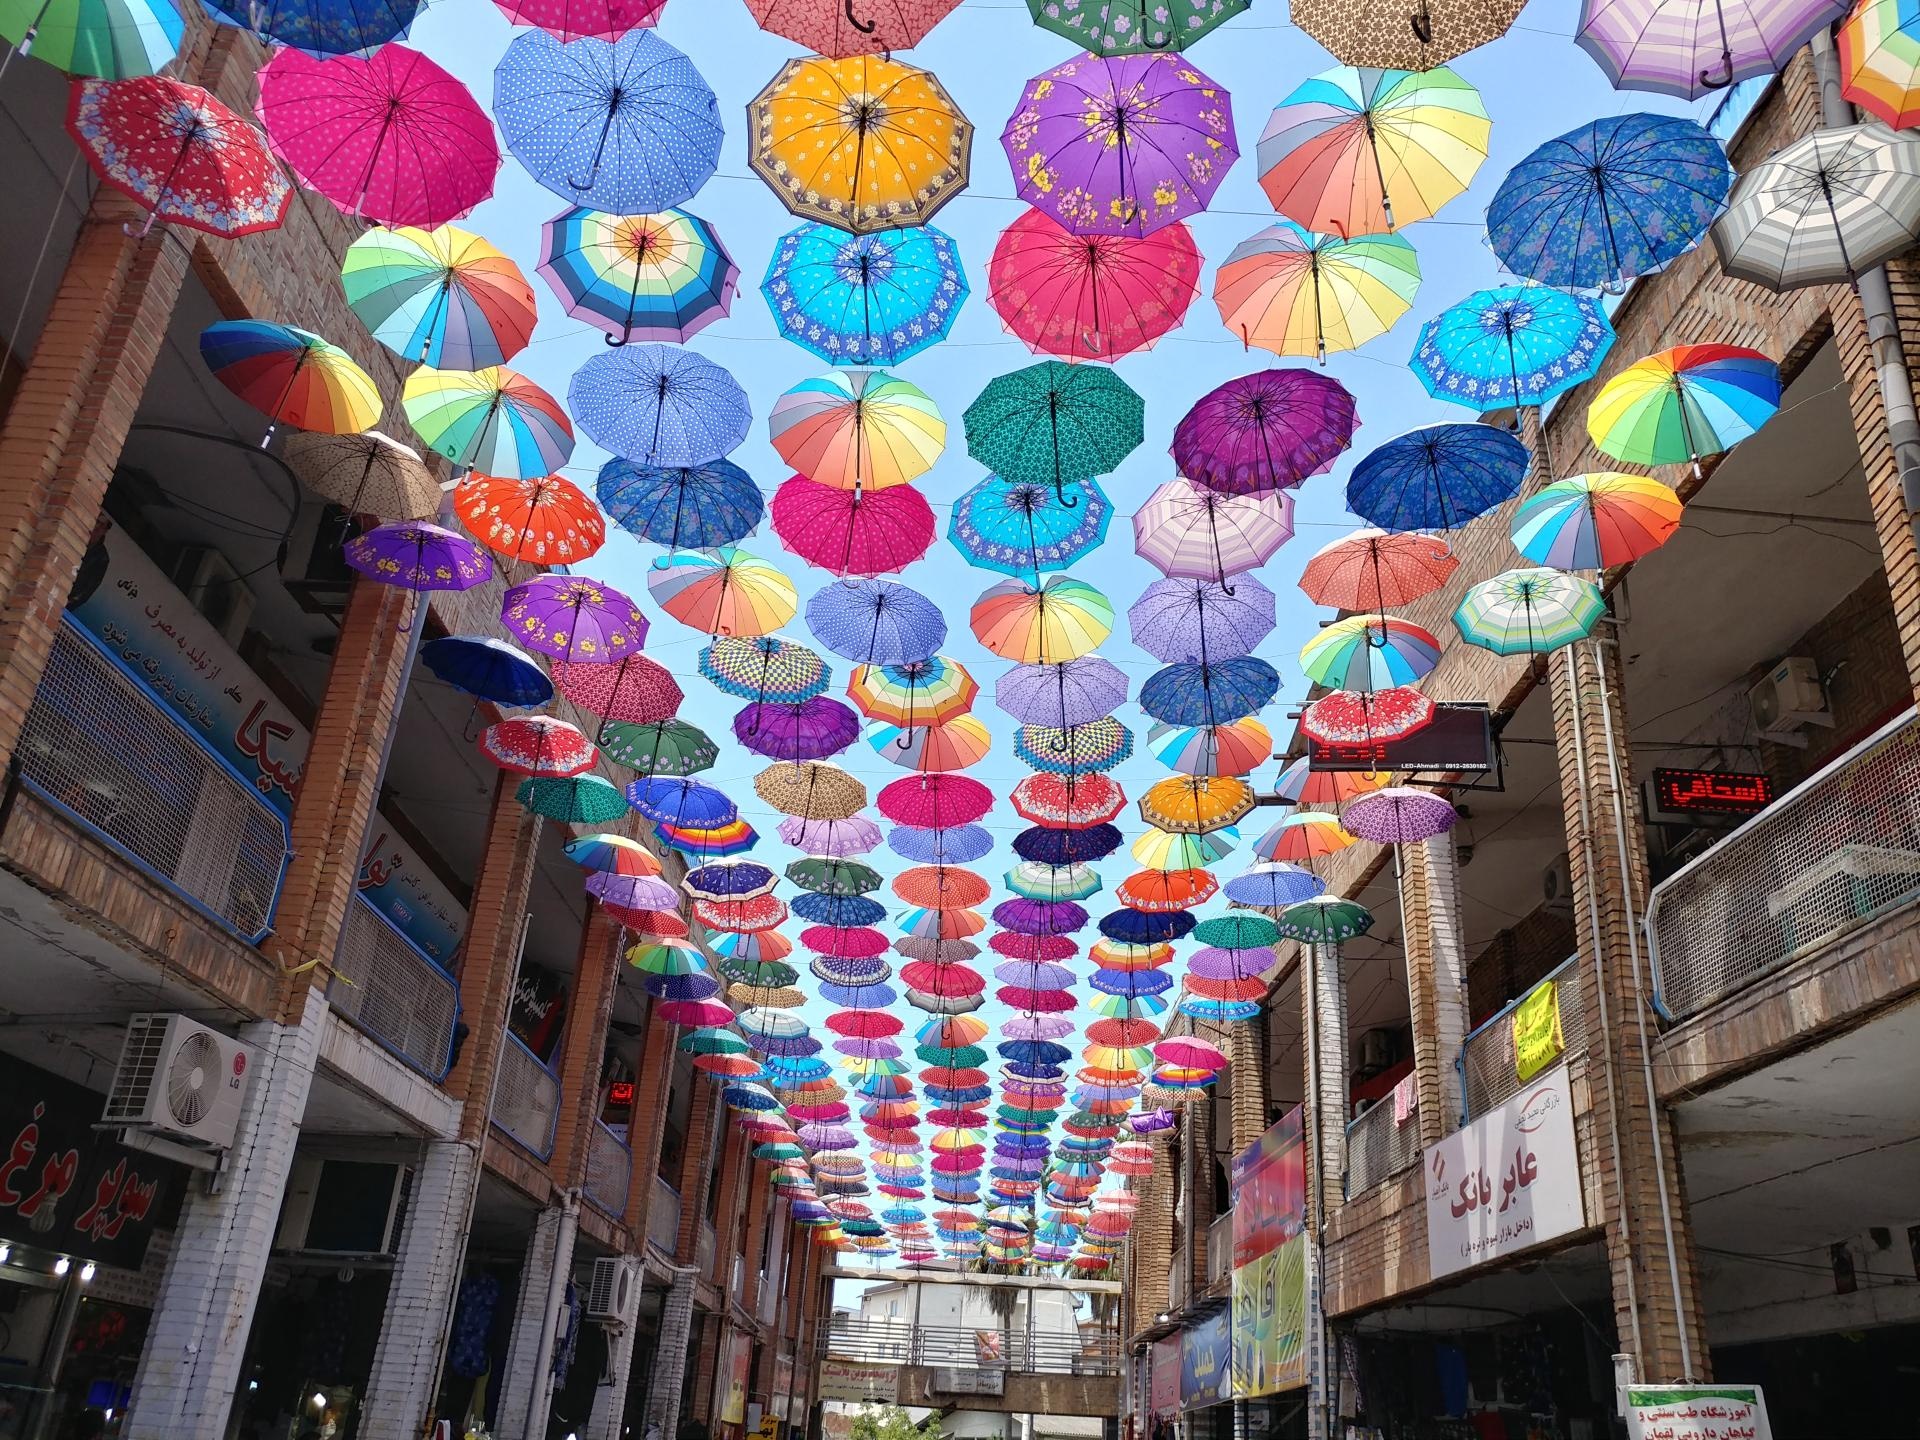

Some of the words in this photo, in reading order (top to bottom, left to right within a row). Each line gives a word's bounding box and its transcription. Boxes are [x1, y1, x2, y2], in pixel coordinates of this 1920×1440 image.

[144, 604, 177, 639] مصرف
[186, 647, 213, 671] تولید
[229, 1077, 240, 1090] LG
[0, 1101, 79, 1218] مرغ
[1499, 1145, 1538, 1213] عابر
[74, 1156, 159, 1243] سوپر
[1450, 1165, 1492, 1219] بانک
[1639, 1411, 1644, 1422] و
[1647, 1407, 1675, 1422] سنتی
[1677, 1406, 1698, 1422] طب
[1701, 1404, 1752, 1421] آموزشگاه
